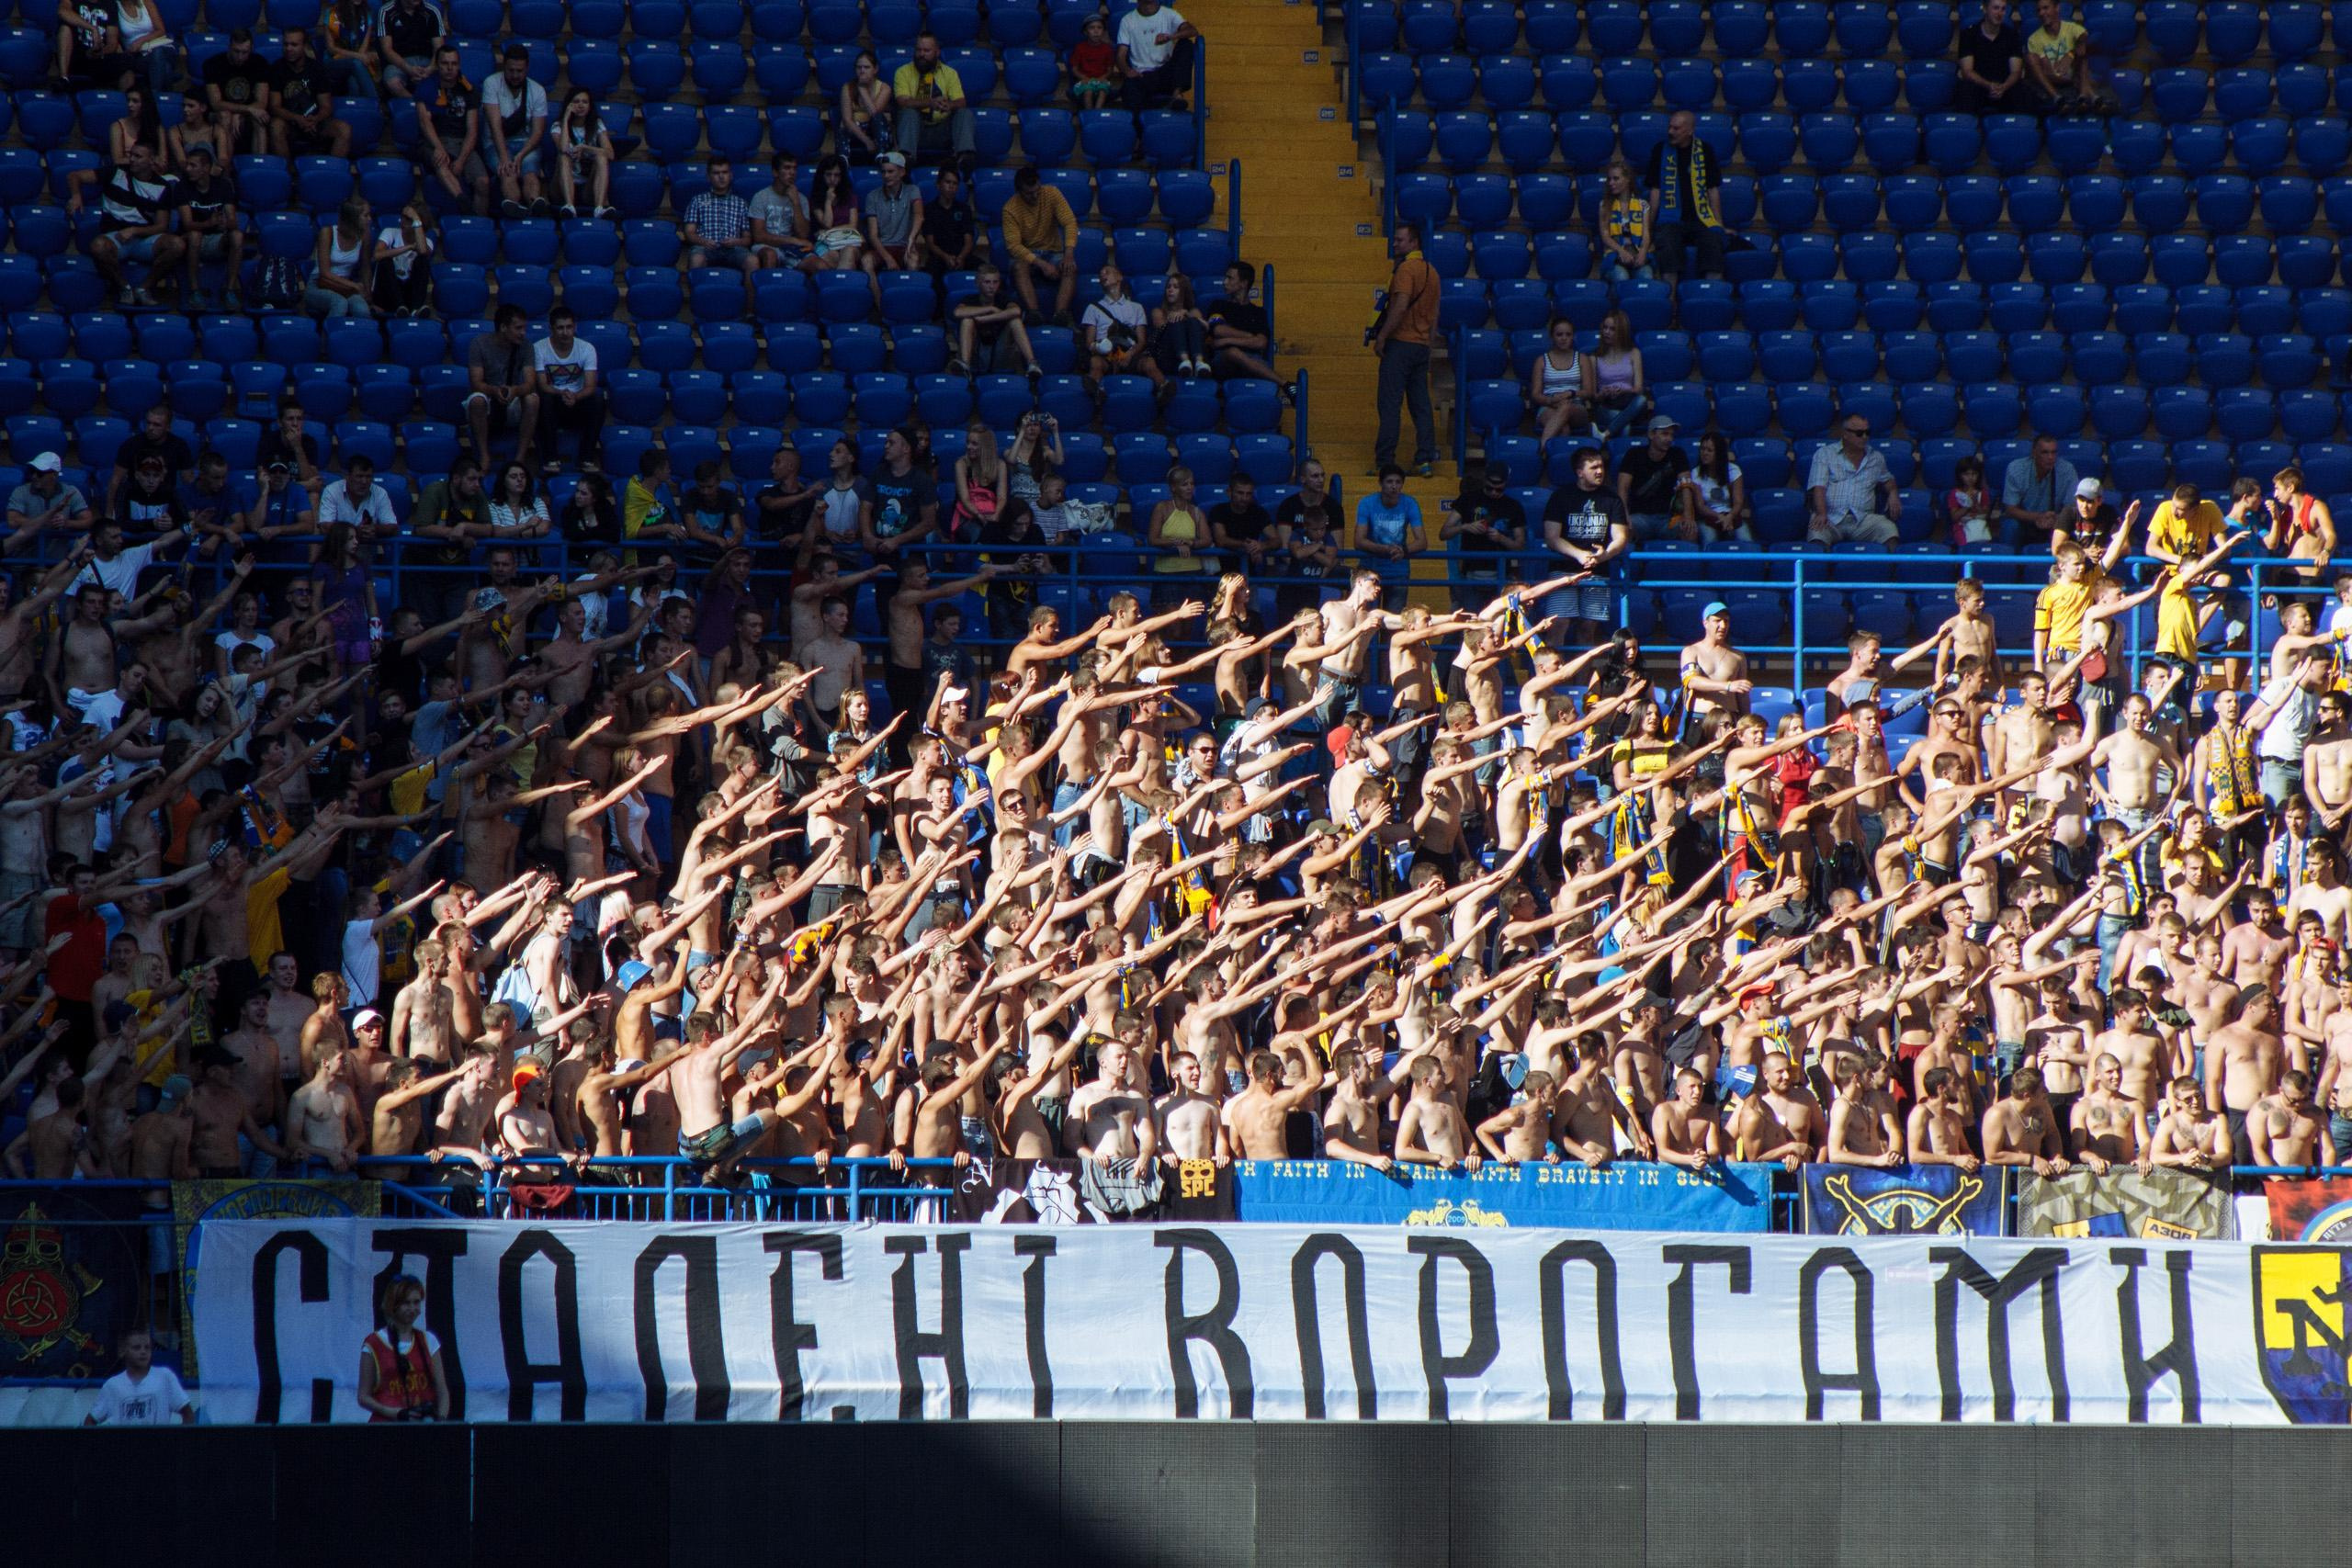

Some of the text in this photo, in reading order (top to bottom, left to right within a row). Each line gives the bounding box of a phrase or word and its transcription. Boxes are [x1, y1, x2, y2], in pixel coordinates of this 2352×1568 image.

[1567, 514, 1609, 527] UKRAINIAN
[1272, 1162, 1330, 1179] FAITH
[1345, 1162, 1366, 1179] IN
[1537, 1167, 1627, 1185] BRAVETY
[1638, 1169, 1660, 1186] IN
[1181, 1179, 1216, 1198] SPC
[1447, 1215, 1465, 1224] 2009
[1154, 1228, 2202, 1423] ВОРОГАМИ
